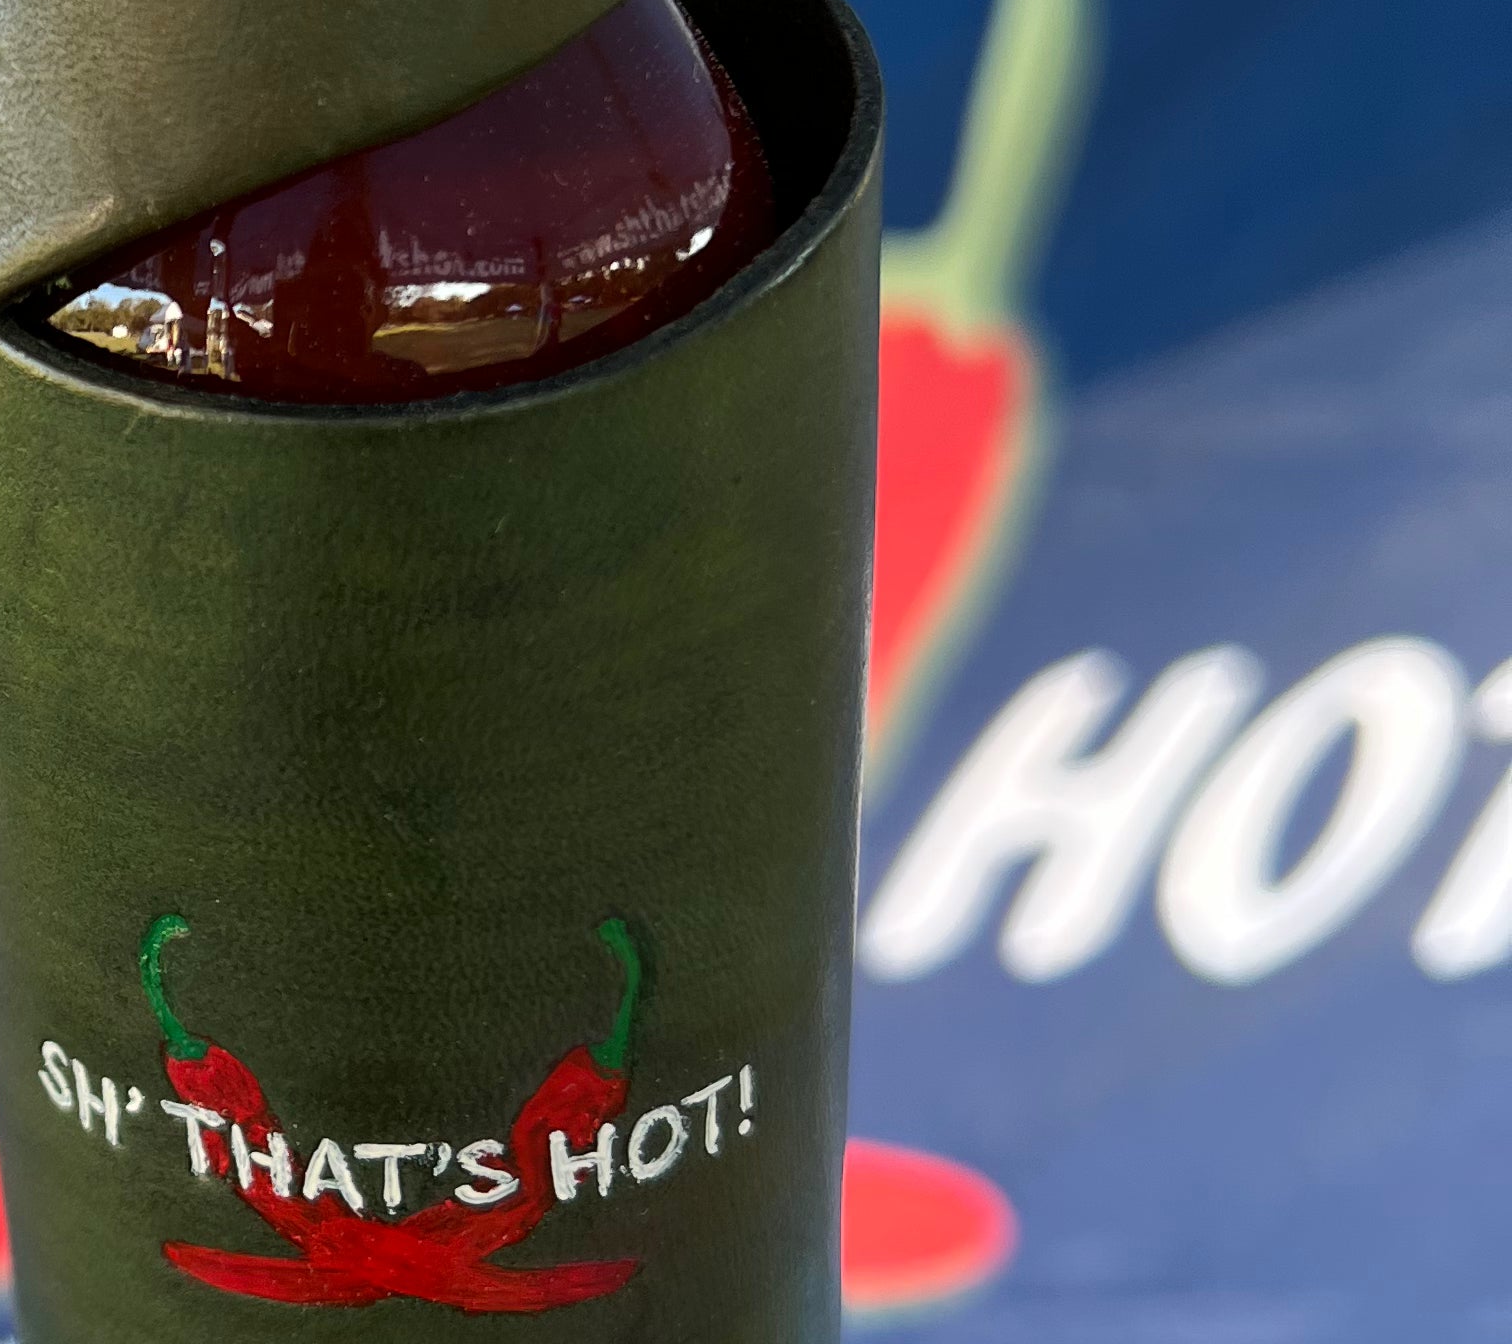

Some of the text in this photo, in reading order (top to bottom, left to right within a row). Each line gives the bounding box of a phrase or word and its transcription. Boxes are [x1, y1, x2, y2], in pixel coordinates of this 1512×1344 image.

[38, 1040, 756, 1216] SH' THAT'S HOT!
